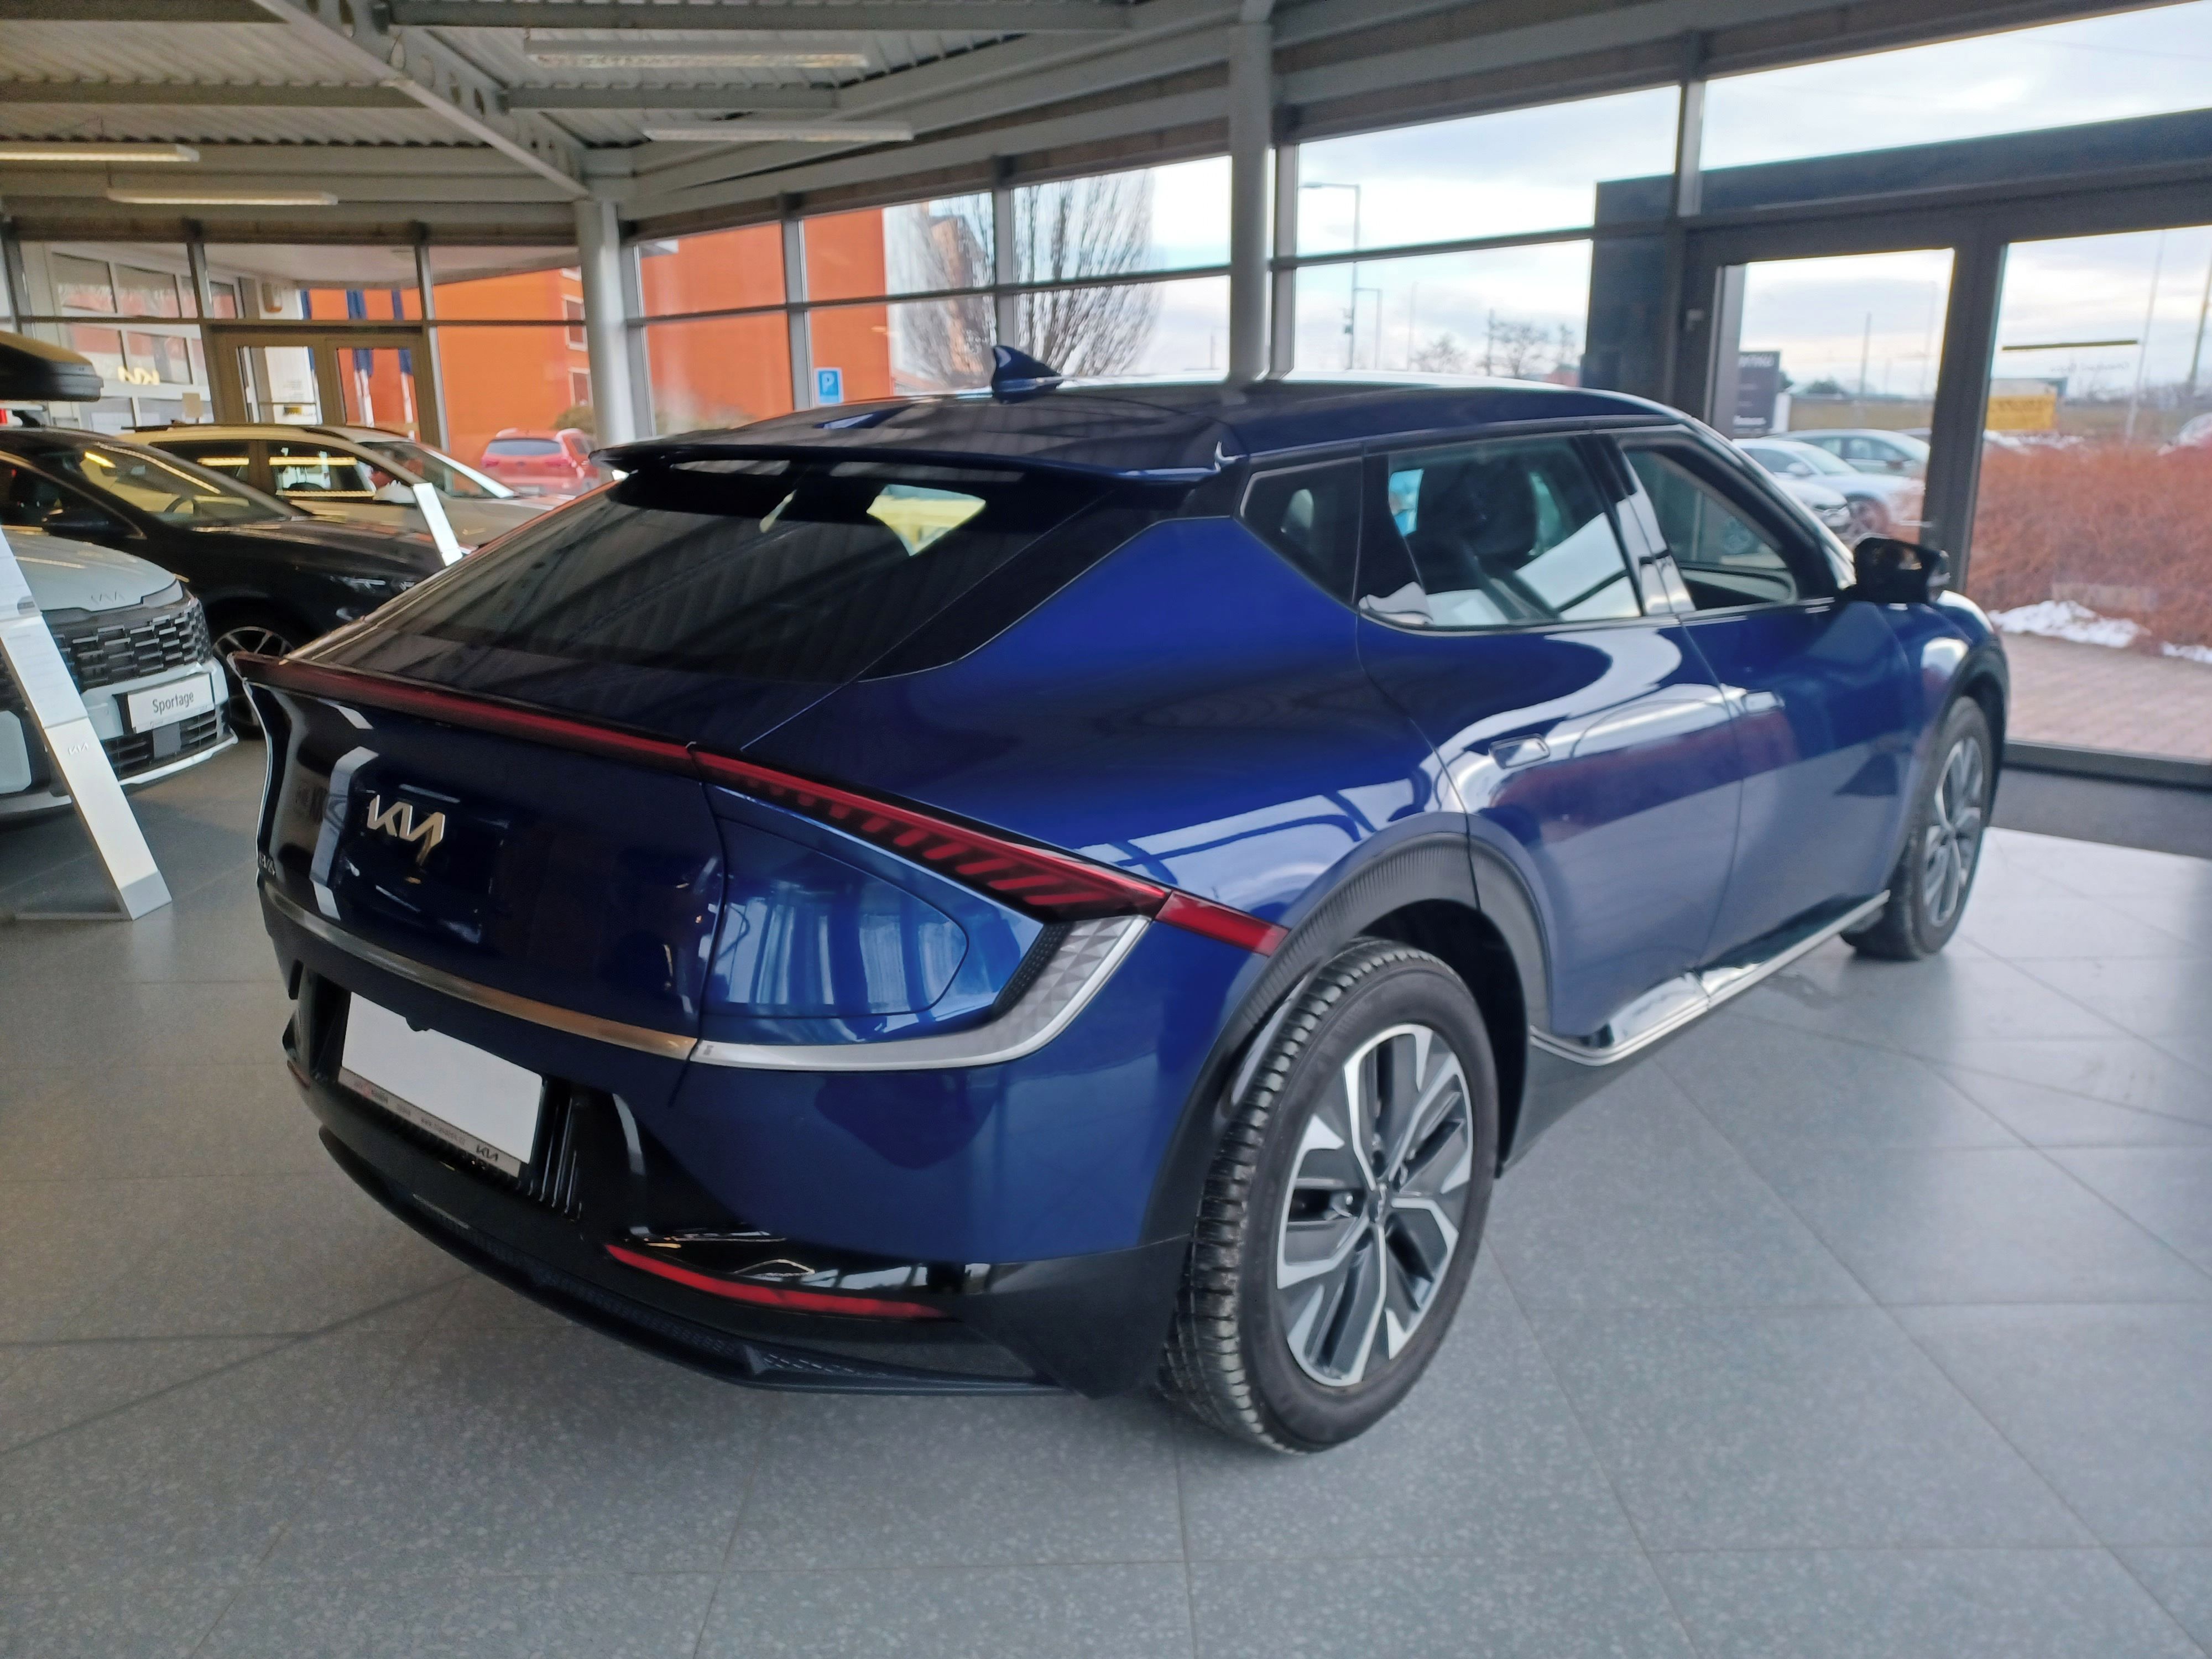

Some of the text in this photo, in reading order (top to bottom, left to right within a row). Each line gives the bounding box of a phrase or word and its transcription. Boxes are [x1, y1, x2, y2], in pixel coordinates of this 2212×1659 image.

[152, 692, 194, 714] Sportage
[367, 794, 446, 847] KIA
[476, 1144, 499, 1161] KIA
